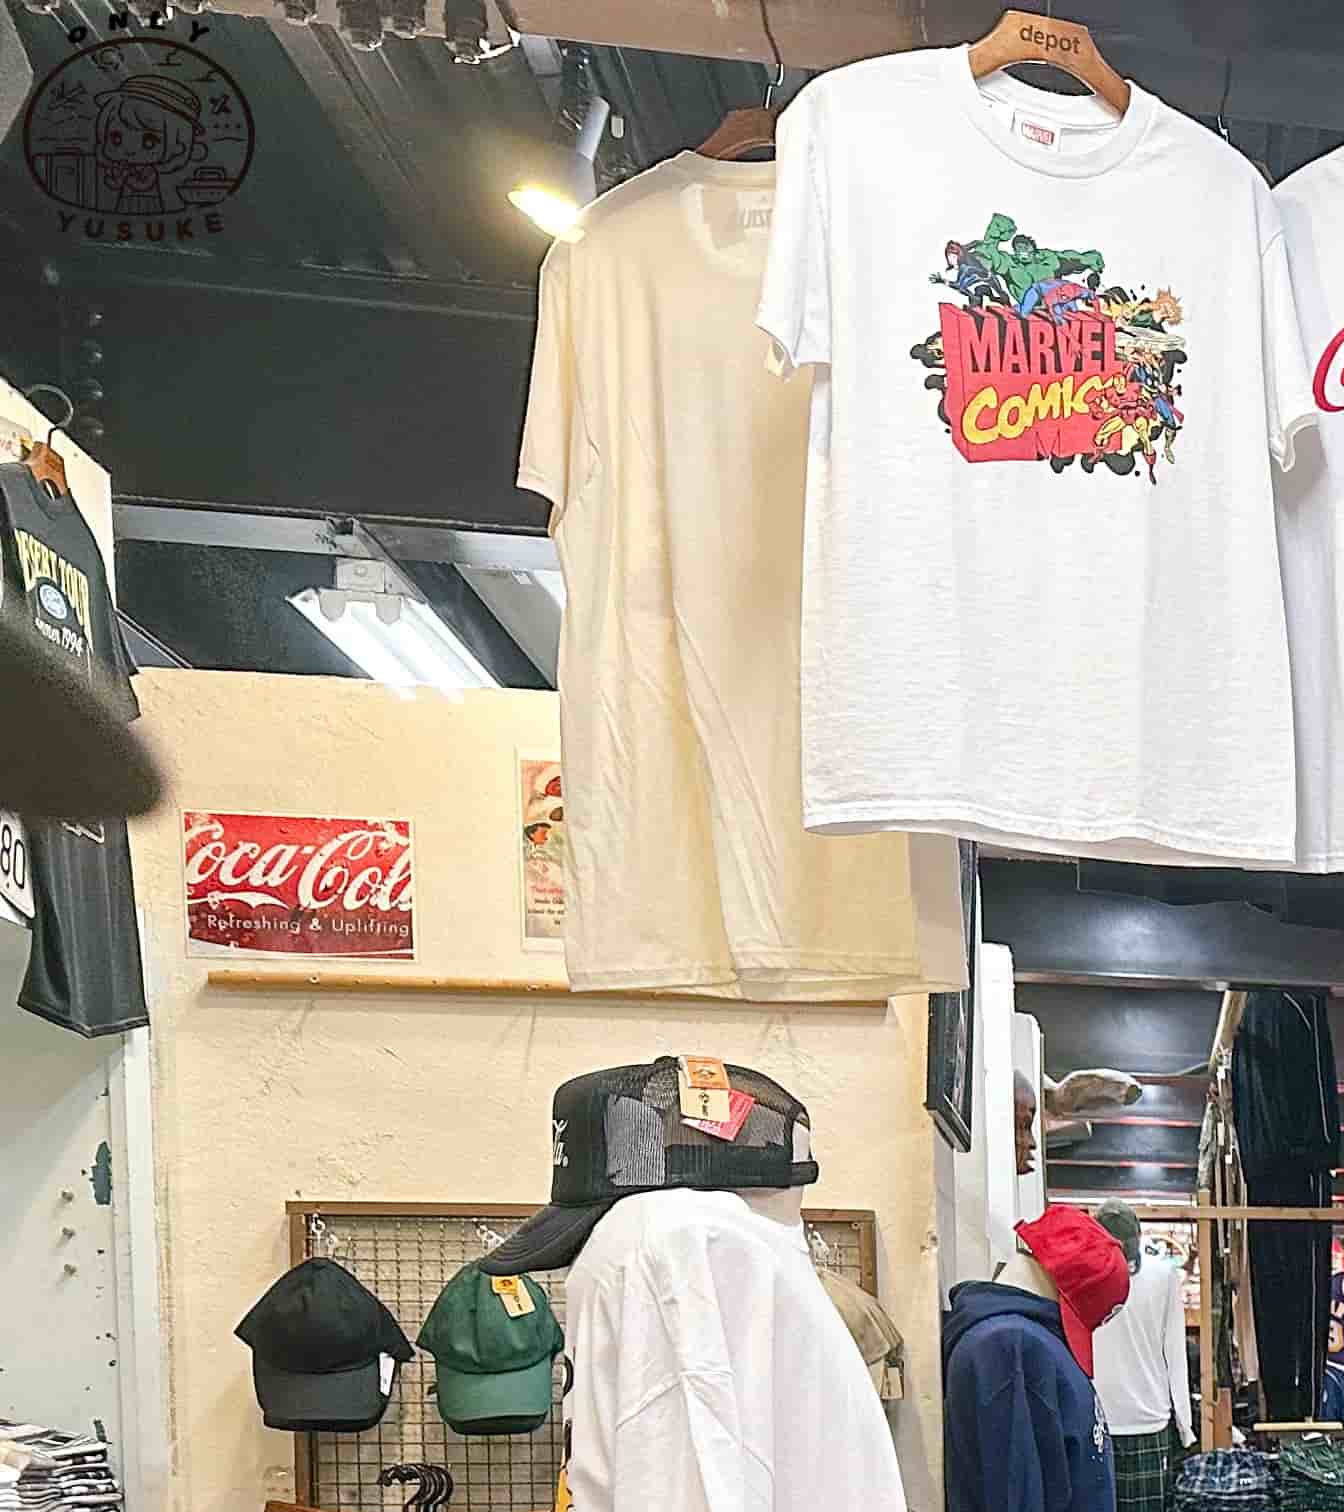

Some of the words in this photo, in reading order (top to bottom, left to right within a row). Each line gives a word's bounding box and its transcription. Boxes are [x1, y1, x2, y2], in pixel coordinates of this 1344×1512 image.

[1020, 25, 1081, 54] depot
[963, 316, 1118, 375] MARVEL
[207, 913, 300, 933] Refreshing
[308, 919, 322, 933] &
[331, 915, 409, 938] Uplifting
